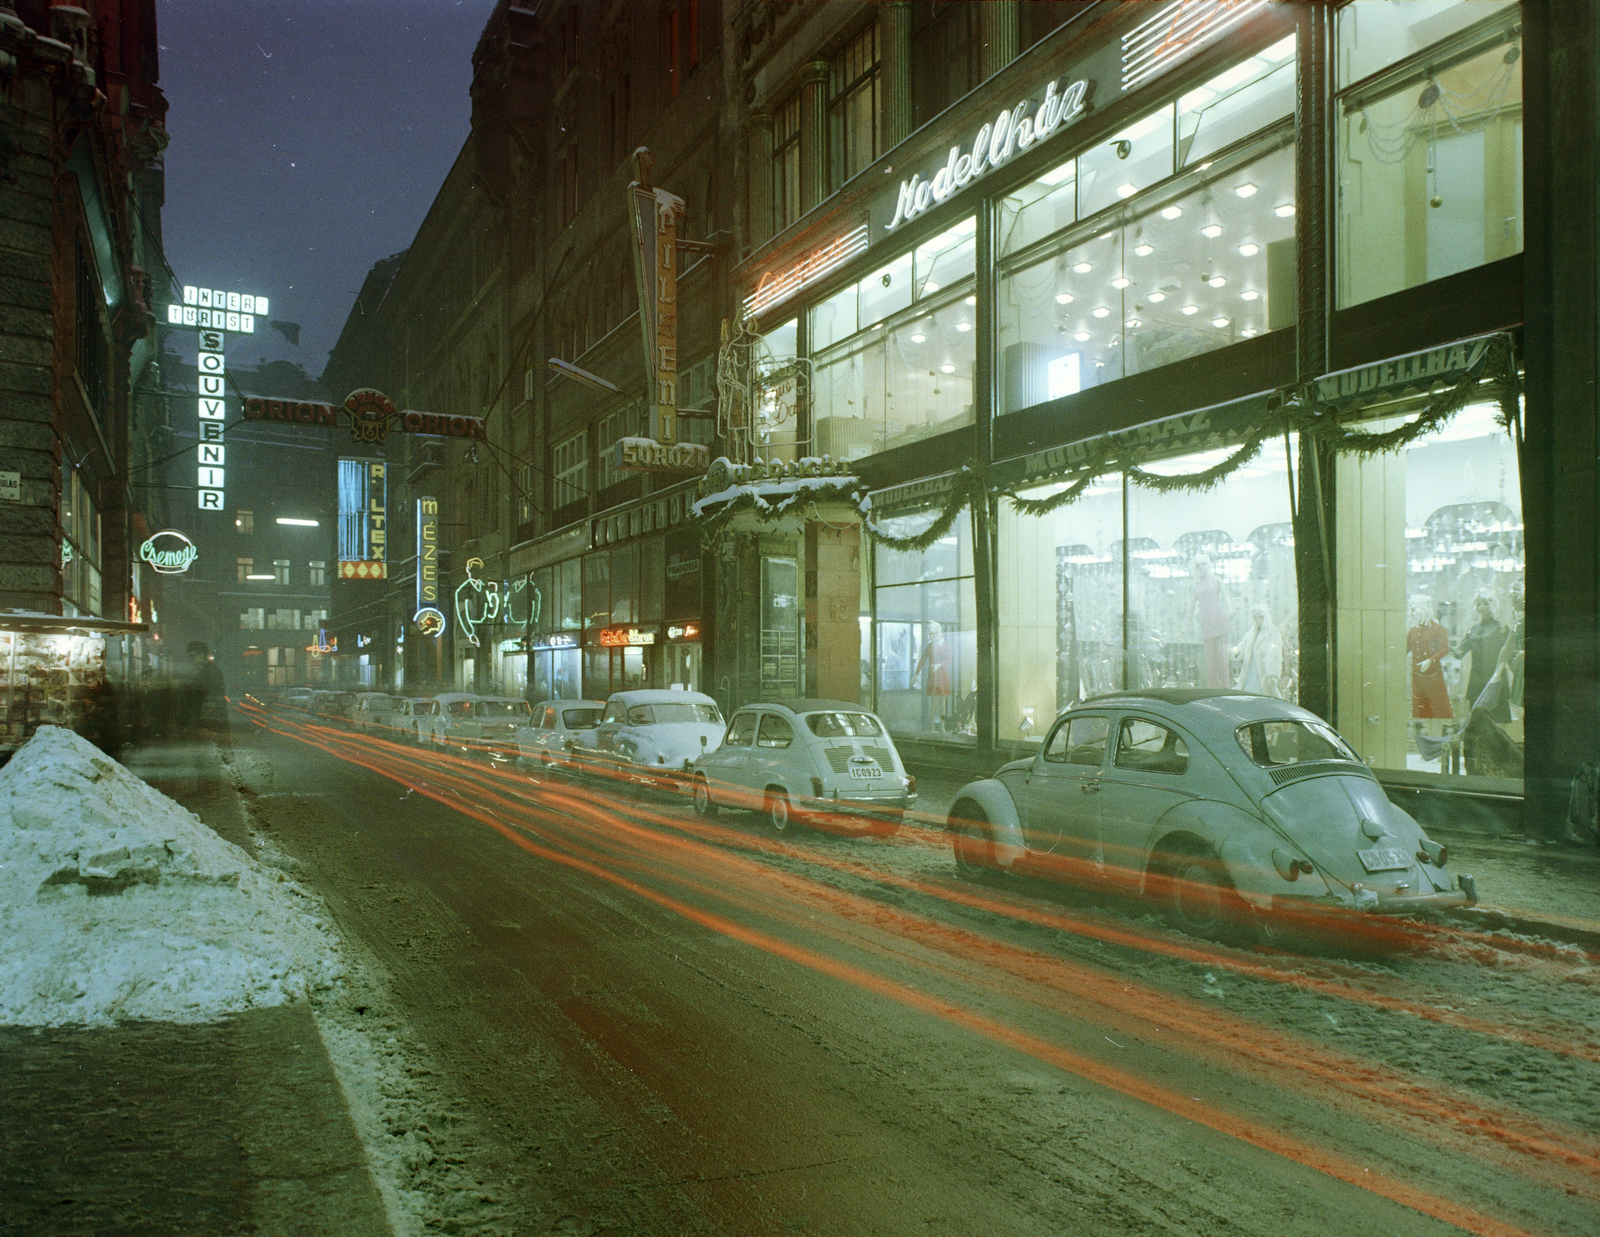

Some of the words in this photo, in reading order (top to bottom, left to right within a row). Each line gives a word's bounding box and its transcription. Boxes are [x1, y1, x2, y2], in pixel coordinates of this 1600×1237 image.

[884, 79, 1087, 229] Modellház
[171, 306, 251, 330] TURIST
[201, 331, 222, 508] SOUVENIR
[244, 397, 337, 427] ORION
[404, 410, 487, 440] ORION
[370, 463, 385, 560] RLTEX
[140, 540, 199, 569] Csemege
